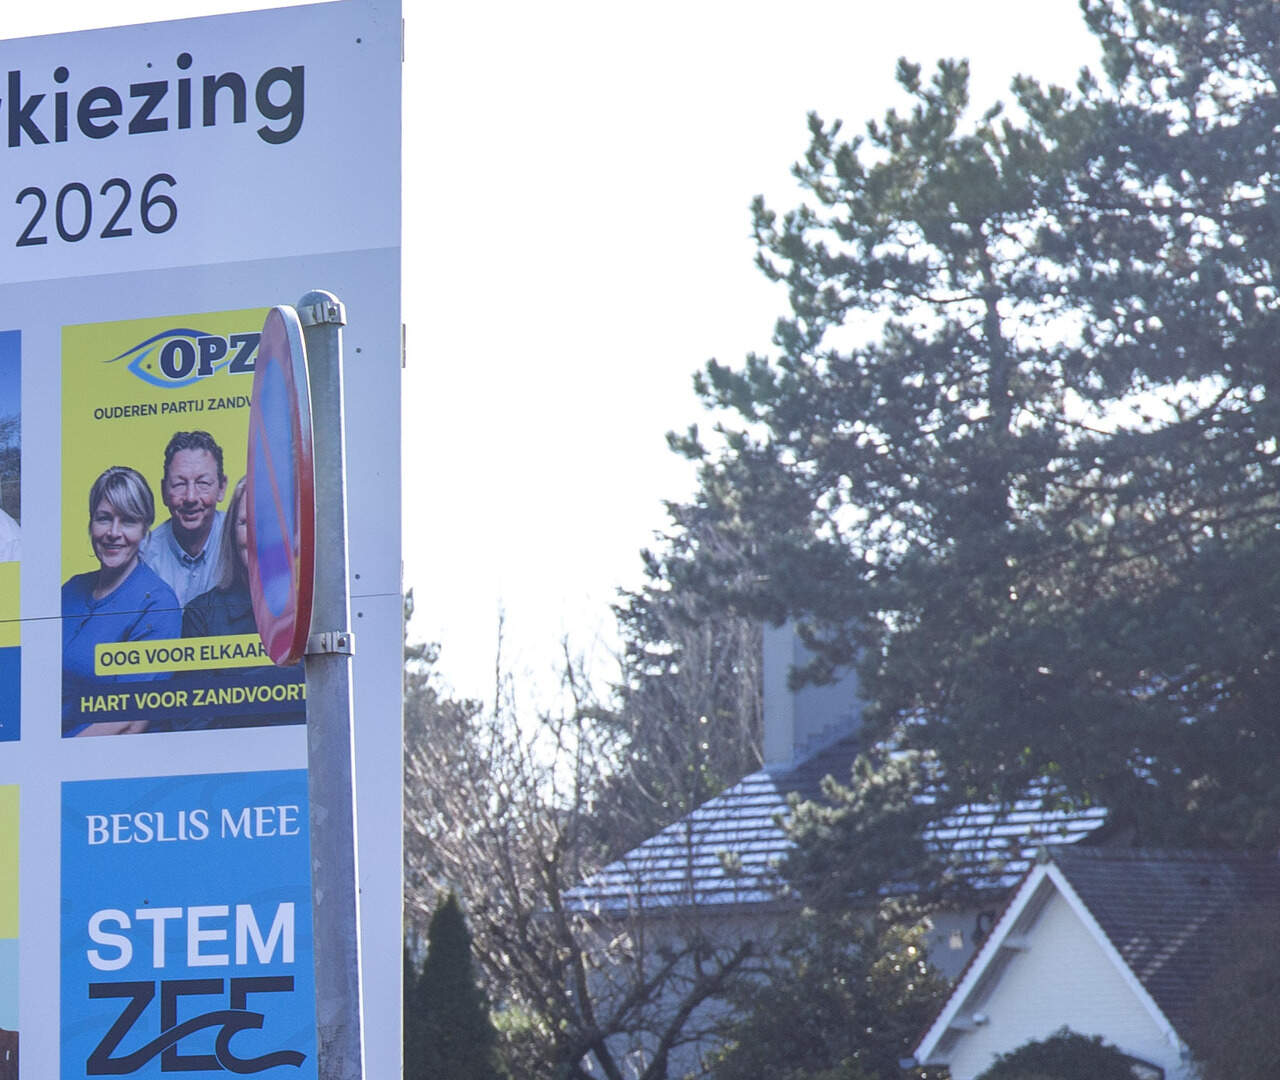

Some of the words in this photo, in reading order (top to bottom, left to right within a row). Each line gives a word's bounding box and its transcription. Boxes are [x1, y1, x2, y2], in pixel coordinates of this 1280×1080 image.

[15, 173, 178, 248] 2026
[160, 332, 263, 380] OPZ
[94, 403, 158, 420] OUDEREN
[161, 400, 204, 415] PARTIJ
[100, 650, 140, 667] OOG
[145, 646, 194, 665] VOOR
[80, 693, 130, 713] HART
[134, 690, 188, 709] VOOR
[86, 808, 209, 845] BESLIS
[221, 805, 301, 839] MEE
[87, 902, 295, 971] STEM
[86, 975, 308, 1076] ZEE
